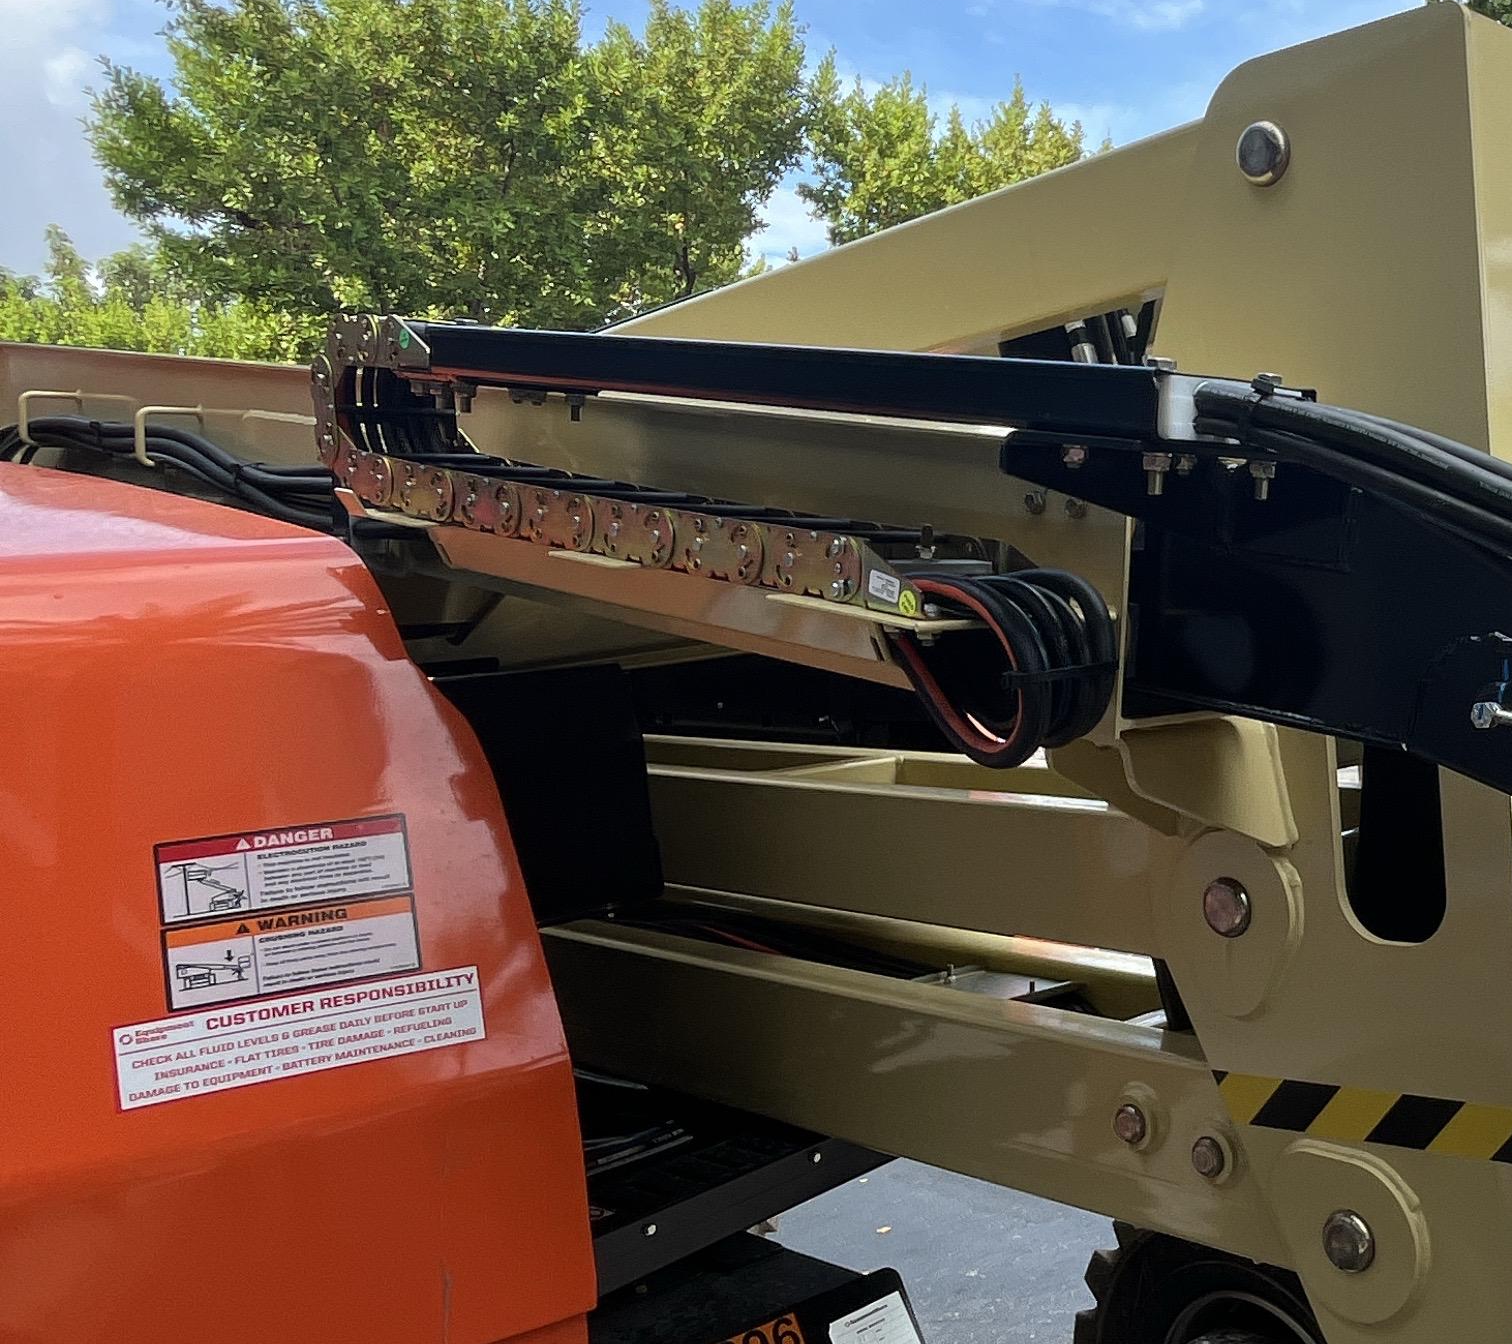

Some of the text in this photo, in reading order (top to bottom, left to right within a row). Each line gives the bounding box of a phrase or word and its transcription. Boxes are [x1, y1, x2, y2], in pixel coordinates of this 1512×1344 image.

[253, 827, 333, 849] DANGER
[257, 908, 348, 931] WARNING
[135, 1020, 195, 1037] Equipment
[206, 972, 474, 1030] CUSTOMER RESPONSIBILITY
[131, 1054, 172, 1069] CHECK
[175, 1050, 197, 1061] ALL
[199, 1041, 234, 1056] FLUID
[237, 1033, 279, 1048] LEVELS
[292, 1022, 336, 1038] GREASE
[339, 1017, 372, 1030] DAILY
[374, 1009, 415, 1023] BEFORE
[418, 1004, 450, 1016] START
[453, 999, 468, 1009] UP
[154, 1060, 226, 1081] INSURANCE
[234, 1053, 264, 1065] FLAT
[264, 1045, 299, 1058] TIRES
[308, 1038, 336, 1051] TIRE
[337, 1029, 385, 1045] DAMAGE
[393, 1016, 452, 1035] REFUELING
[128, 1083, 181, 1102] DAMAGE
[183, 1079, 200, 1091] TO
[203, 1065, 273, 1087] EQUIPMENT
[282, 1054, 333, 1071] BATTERY
[334, 1038, 416, 1060] MAINTENANCE
[423, 1027, 477, 1044] CLEANING
